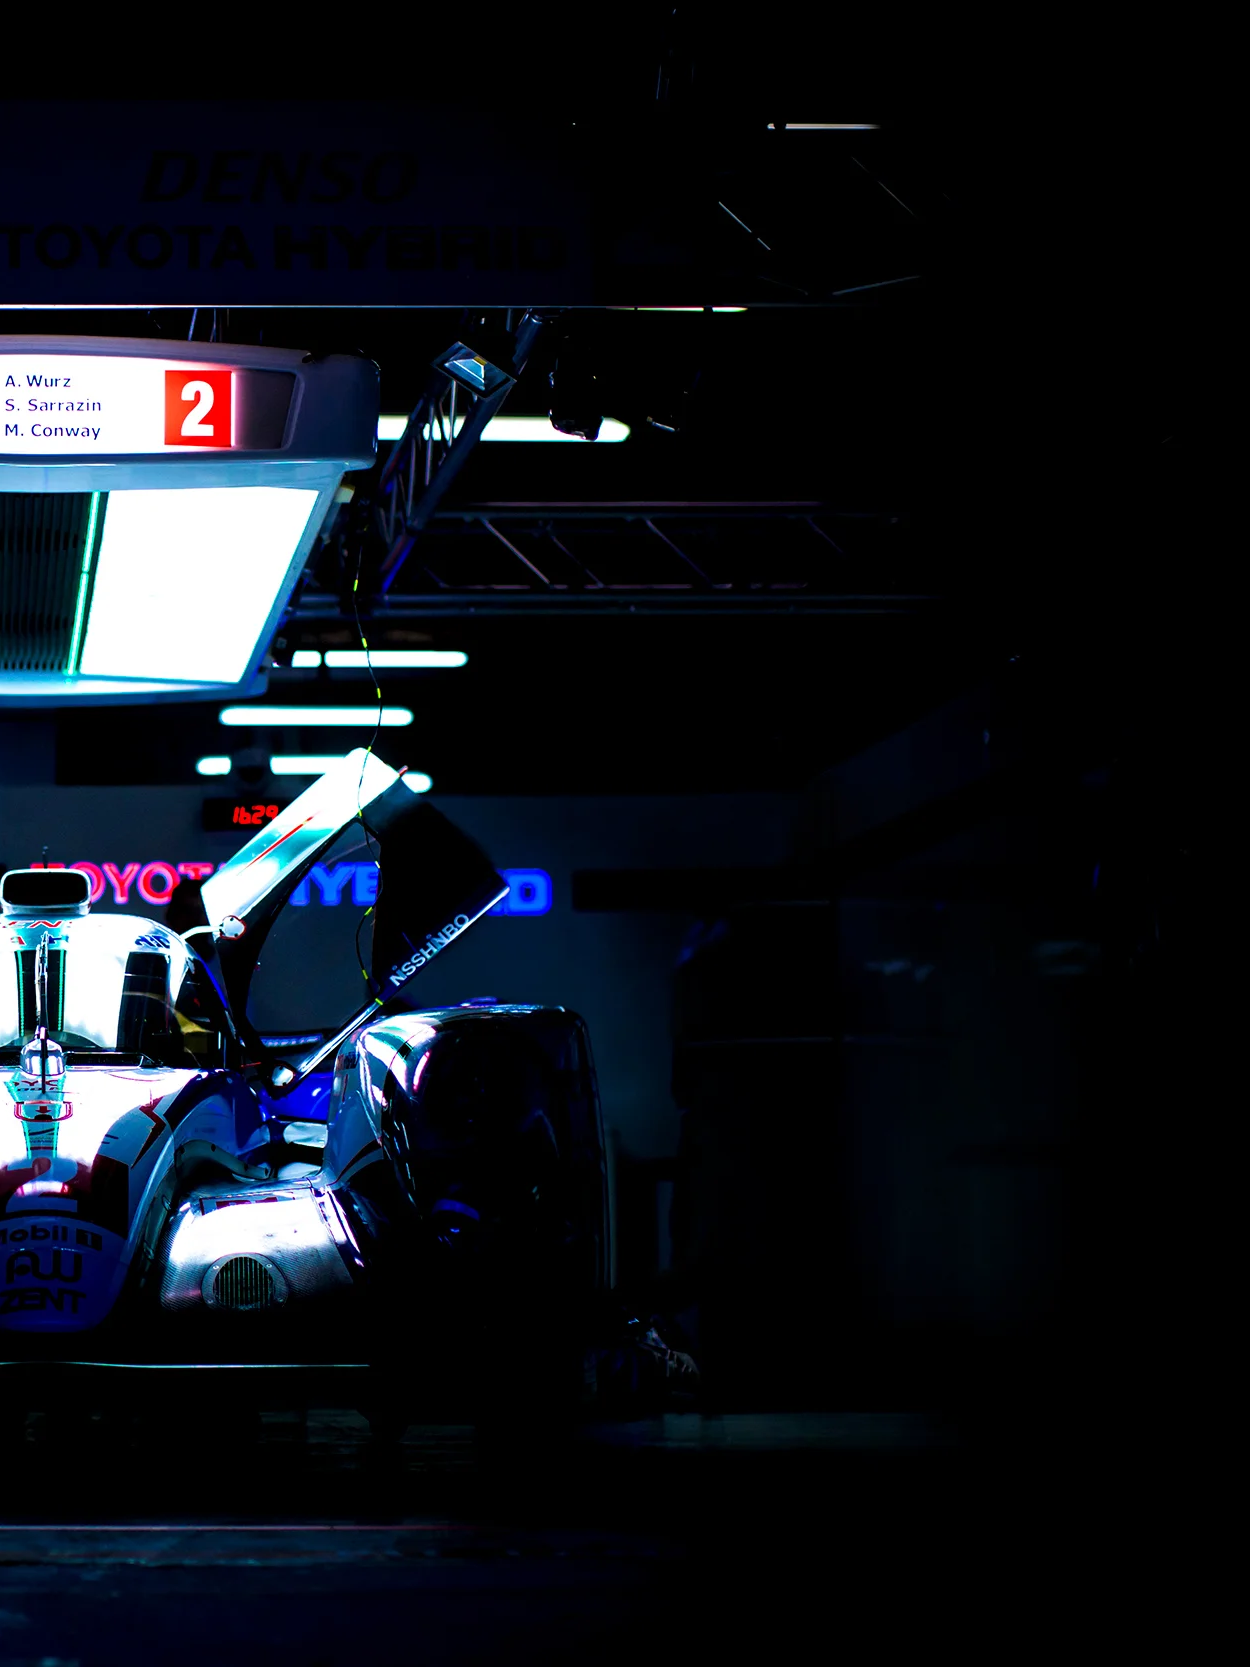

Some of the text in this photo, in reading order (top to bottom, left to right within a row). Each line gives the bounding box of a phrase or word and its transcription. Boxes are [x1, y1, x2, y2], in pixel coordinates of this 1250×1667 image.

[140, 149, 419, 204] DENSO
[5, 375, 71, 387] A. Wurz
[5, 398, 101, 411] S. Sarrazin
[180, 380, 215, 437] 2
[5, 423, 101, 440] M. Conway
